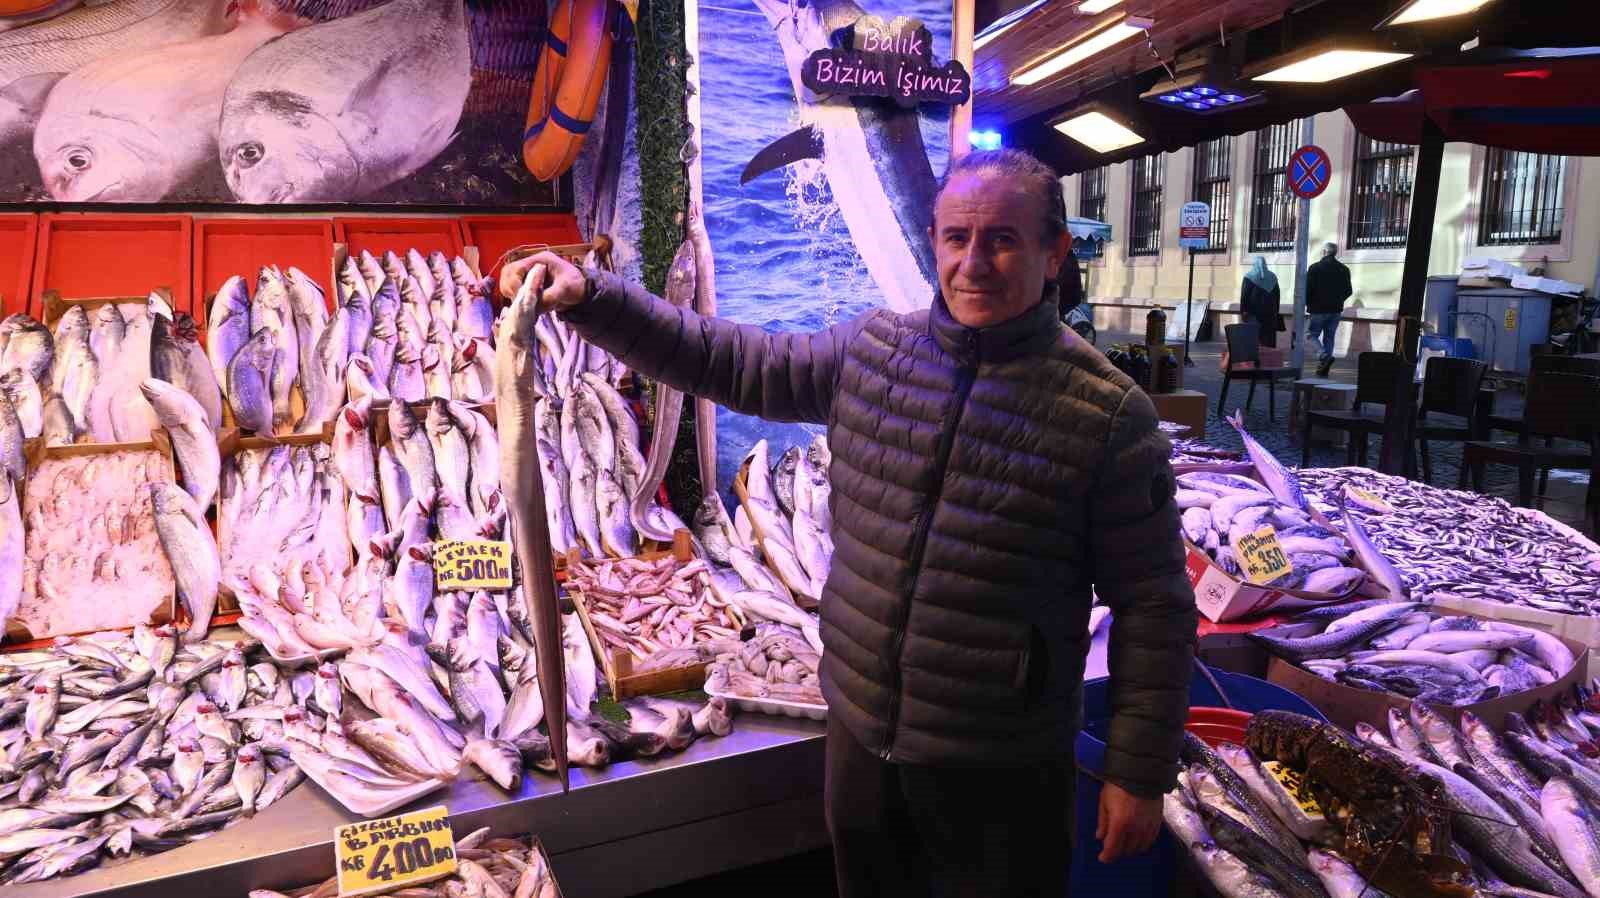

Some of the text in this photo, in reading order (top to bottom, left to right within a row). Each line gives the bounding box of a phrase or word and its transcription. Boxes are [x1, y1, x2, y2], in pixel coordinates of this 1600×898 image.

[863, 28, 923, 56] Balık
[816, 58, 963, 97] Bizim İşimiz
[437, 545, 503, 567] LEVREK
[1258, 547, 1287, 574] 350
[345, 816, 451, 851] BARBUN
